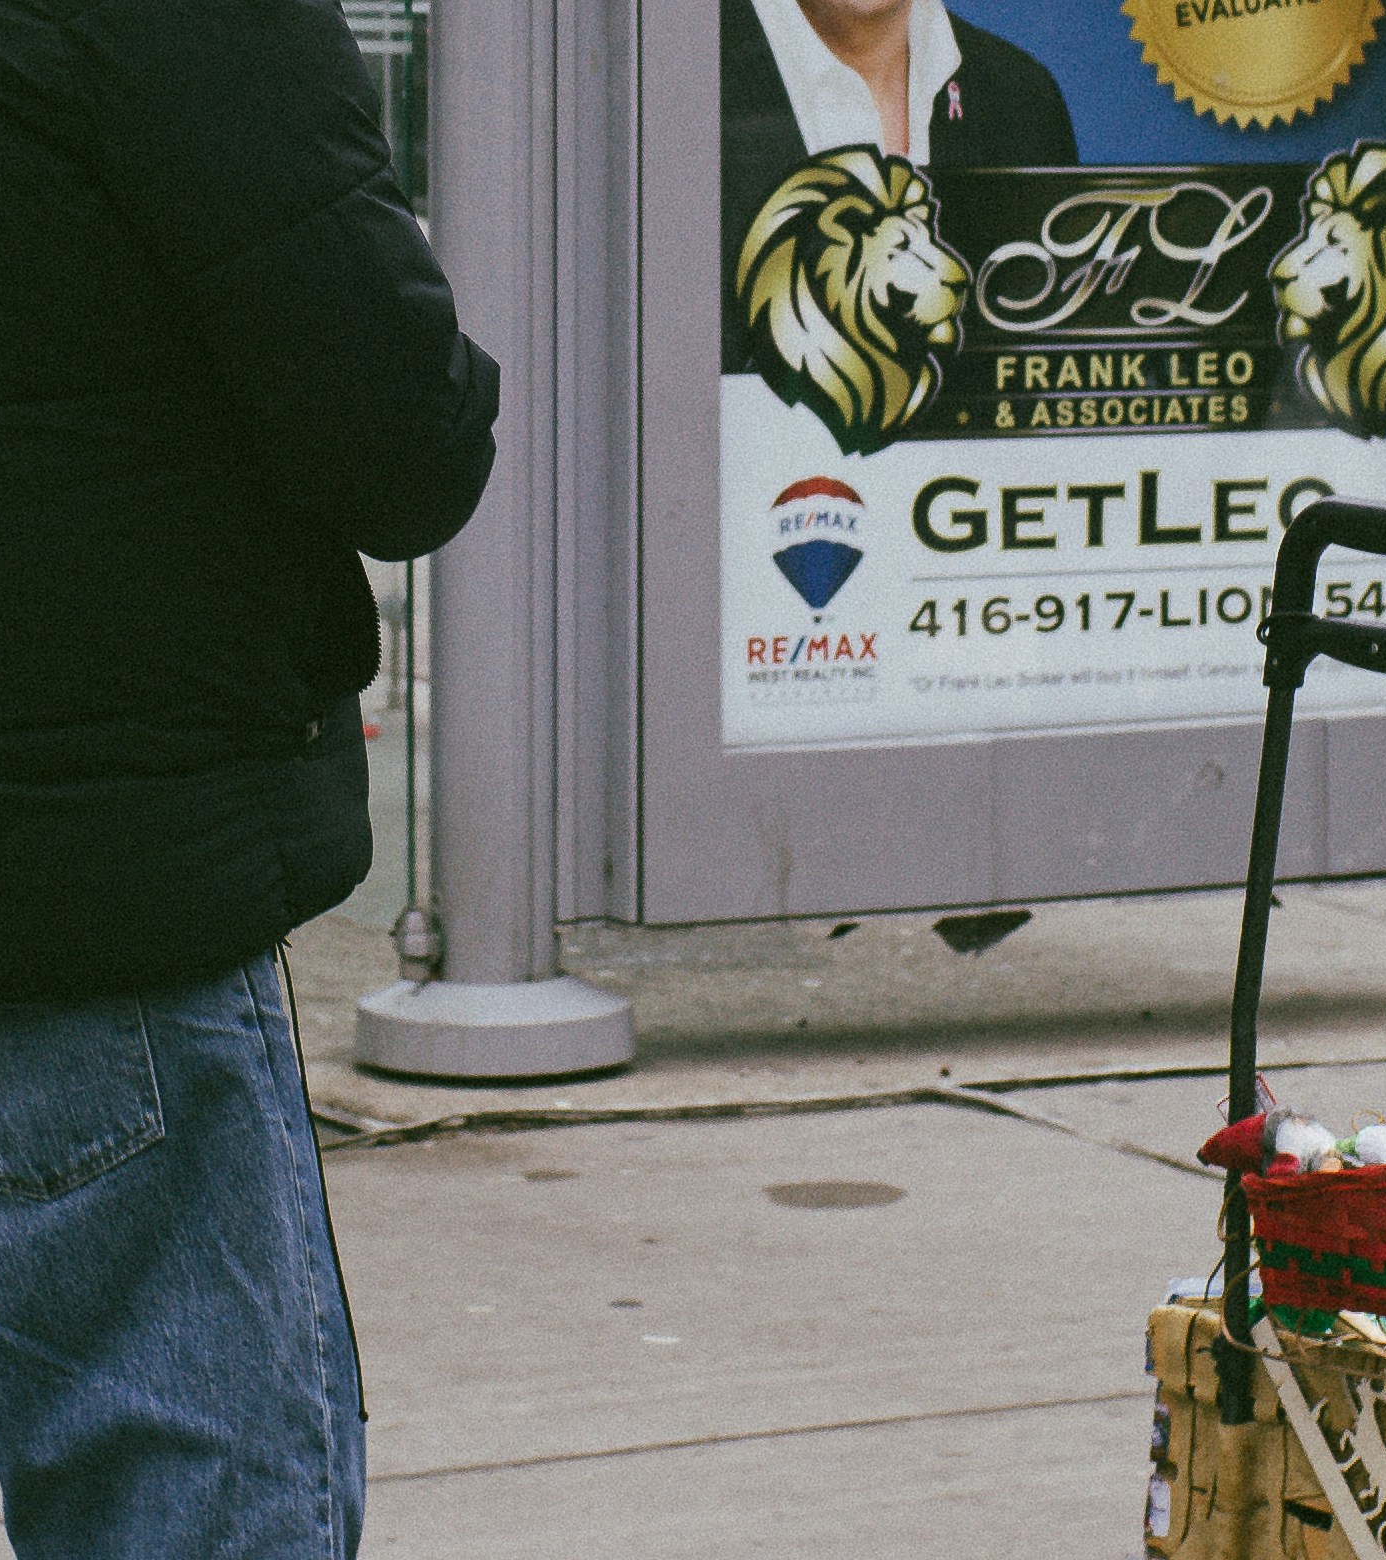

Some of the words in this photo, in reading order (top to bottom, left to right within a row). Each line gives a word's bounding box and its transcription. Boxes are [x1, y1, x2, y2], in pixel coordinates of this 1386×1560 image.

[996, 353, 1147, 391] FRANK
[1169, 351, 1254, 386] LEO
[995, 399, 1015, 428] &
[1029, 395, 1249, 427] ASSOCIATES
[779, 510, 859, 535] RE/MAX
[746, 631, 879, 665] RE/MAX
